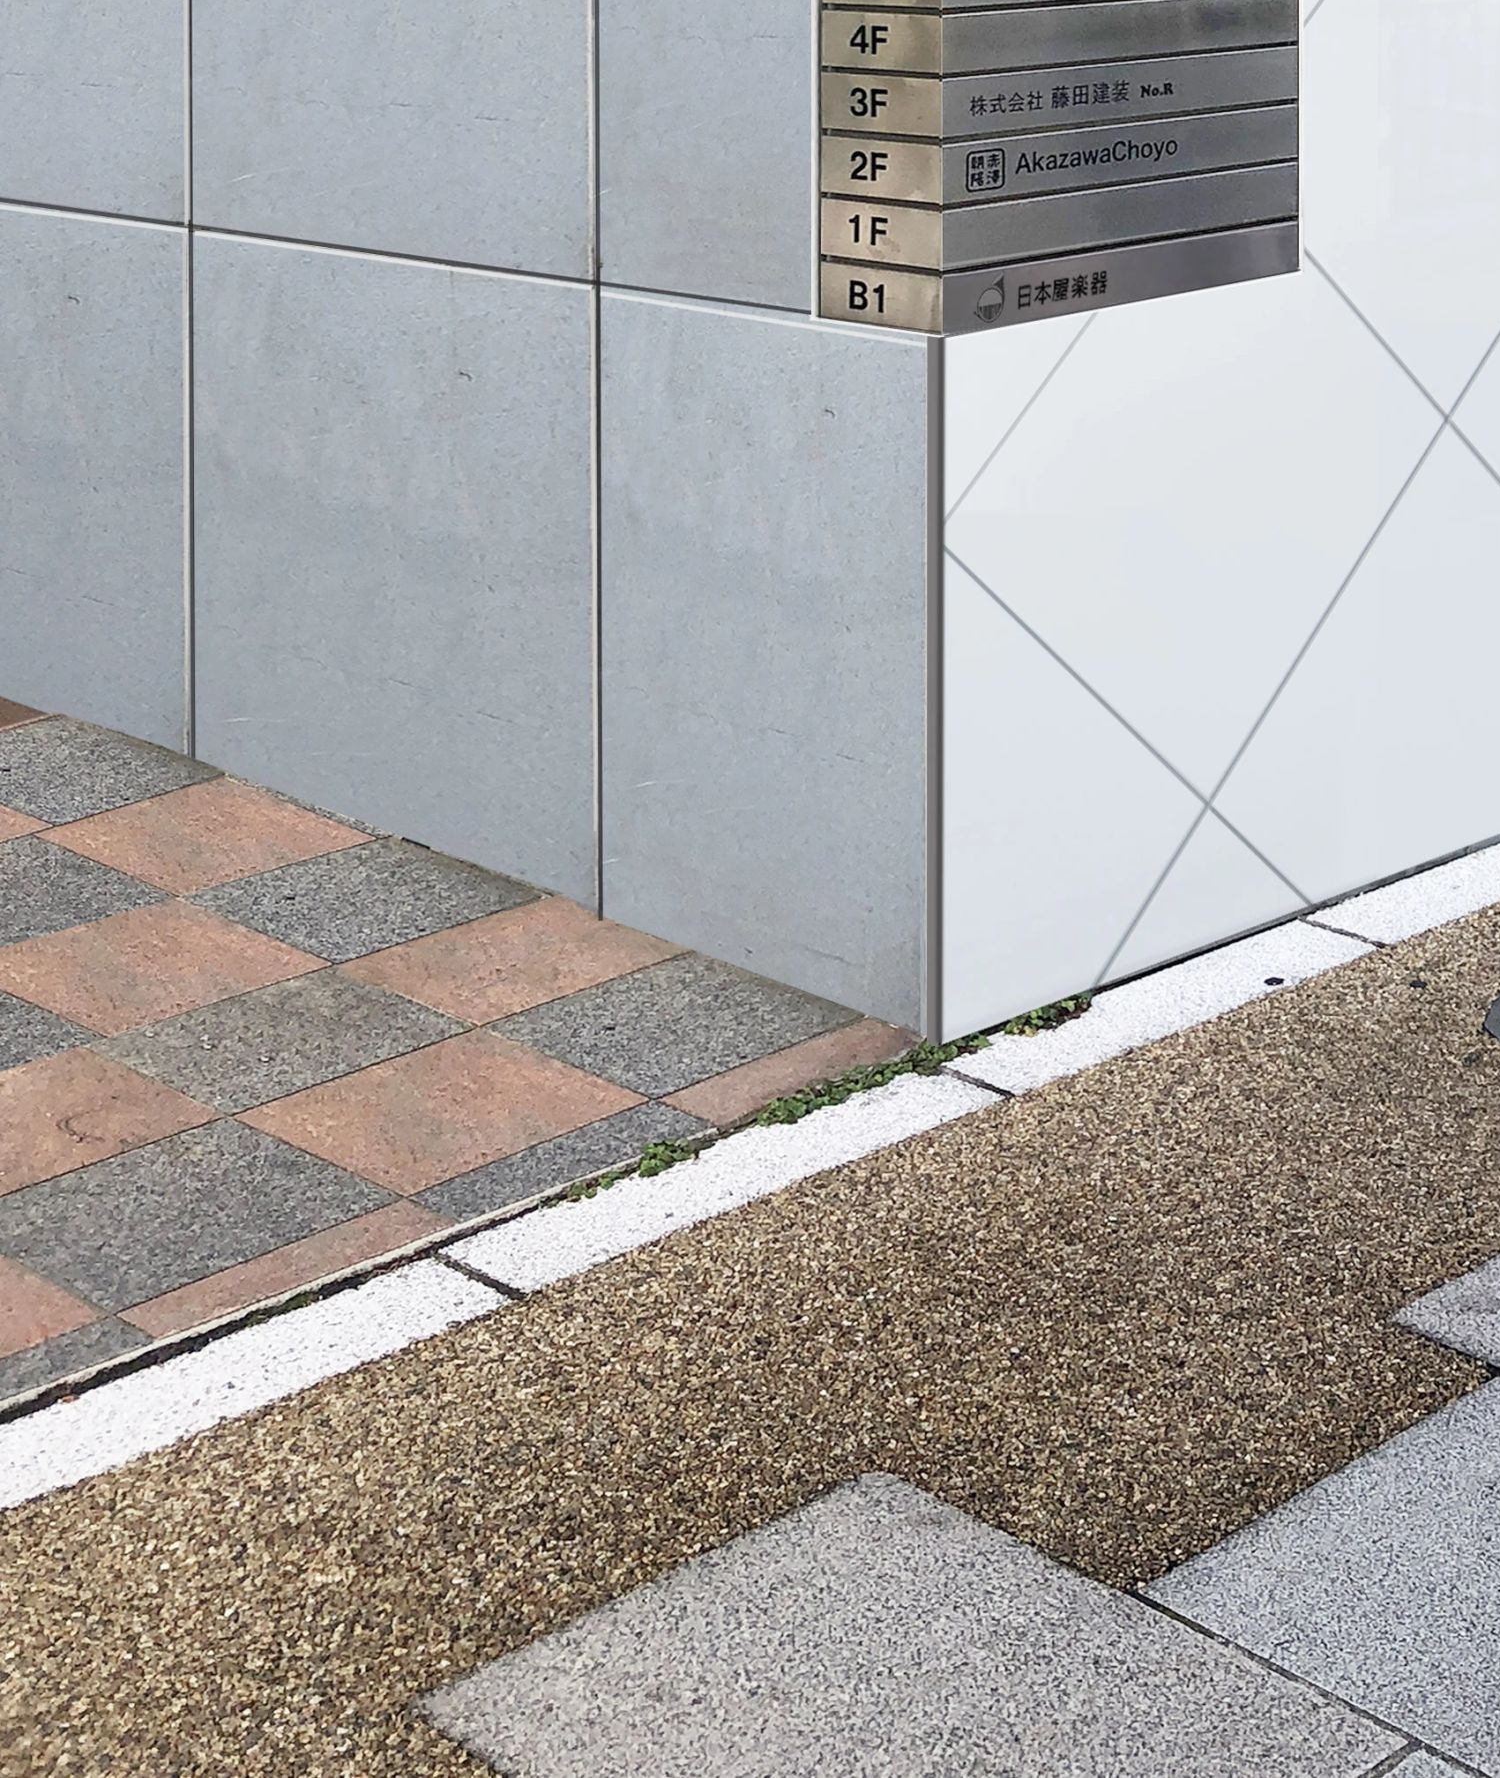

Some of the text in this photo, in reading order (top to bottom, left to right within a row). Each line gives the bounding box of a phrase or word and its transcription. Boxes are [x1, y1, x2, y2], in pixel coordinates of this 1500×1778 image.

[849, 25, 888, 56] 4F
[850, 88, 888, 118] 3F
[969, 91, 1043, 117] 株式会社
[849, 152, 888, 182] 2F
[1015, 139, 1179, 175] AkazawaChoyo
[848, 215, 888, 246] 1F
[848, 280, 887, 315] B1
[1017, 271, 1108, 311] 日本屋楽器
